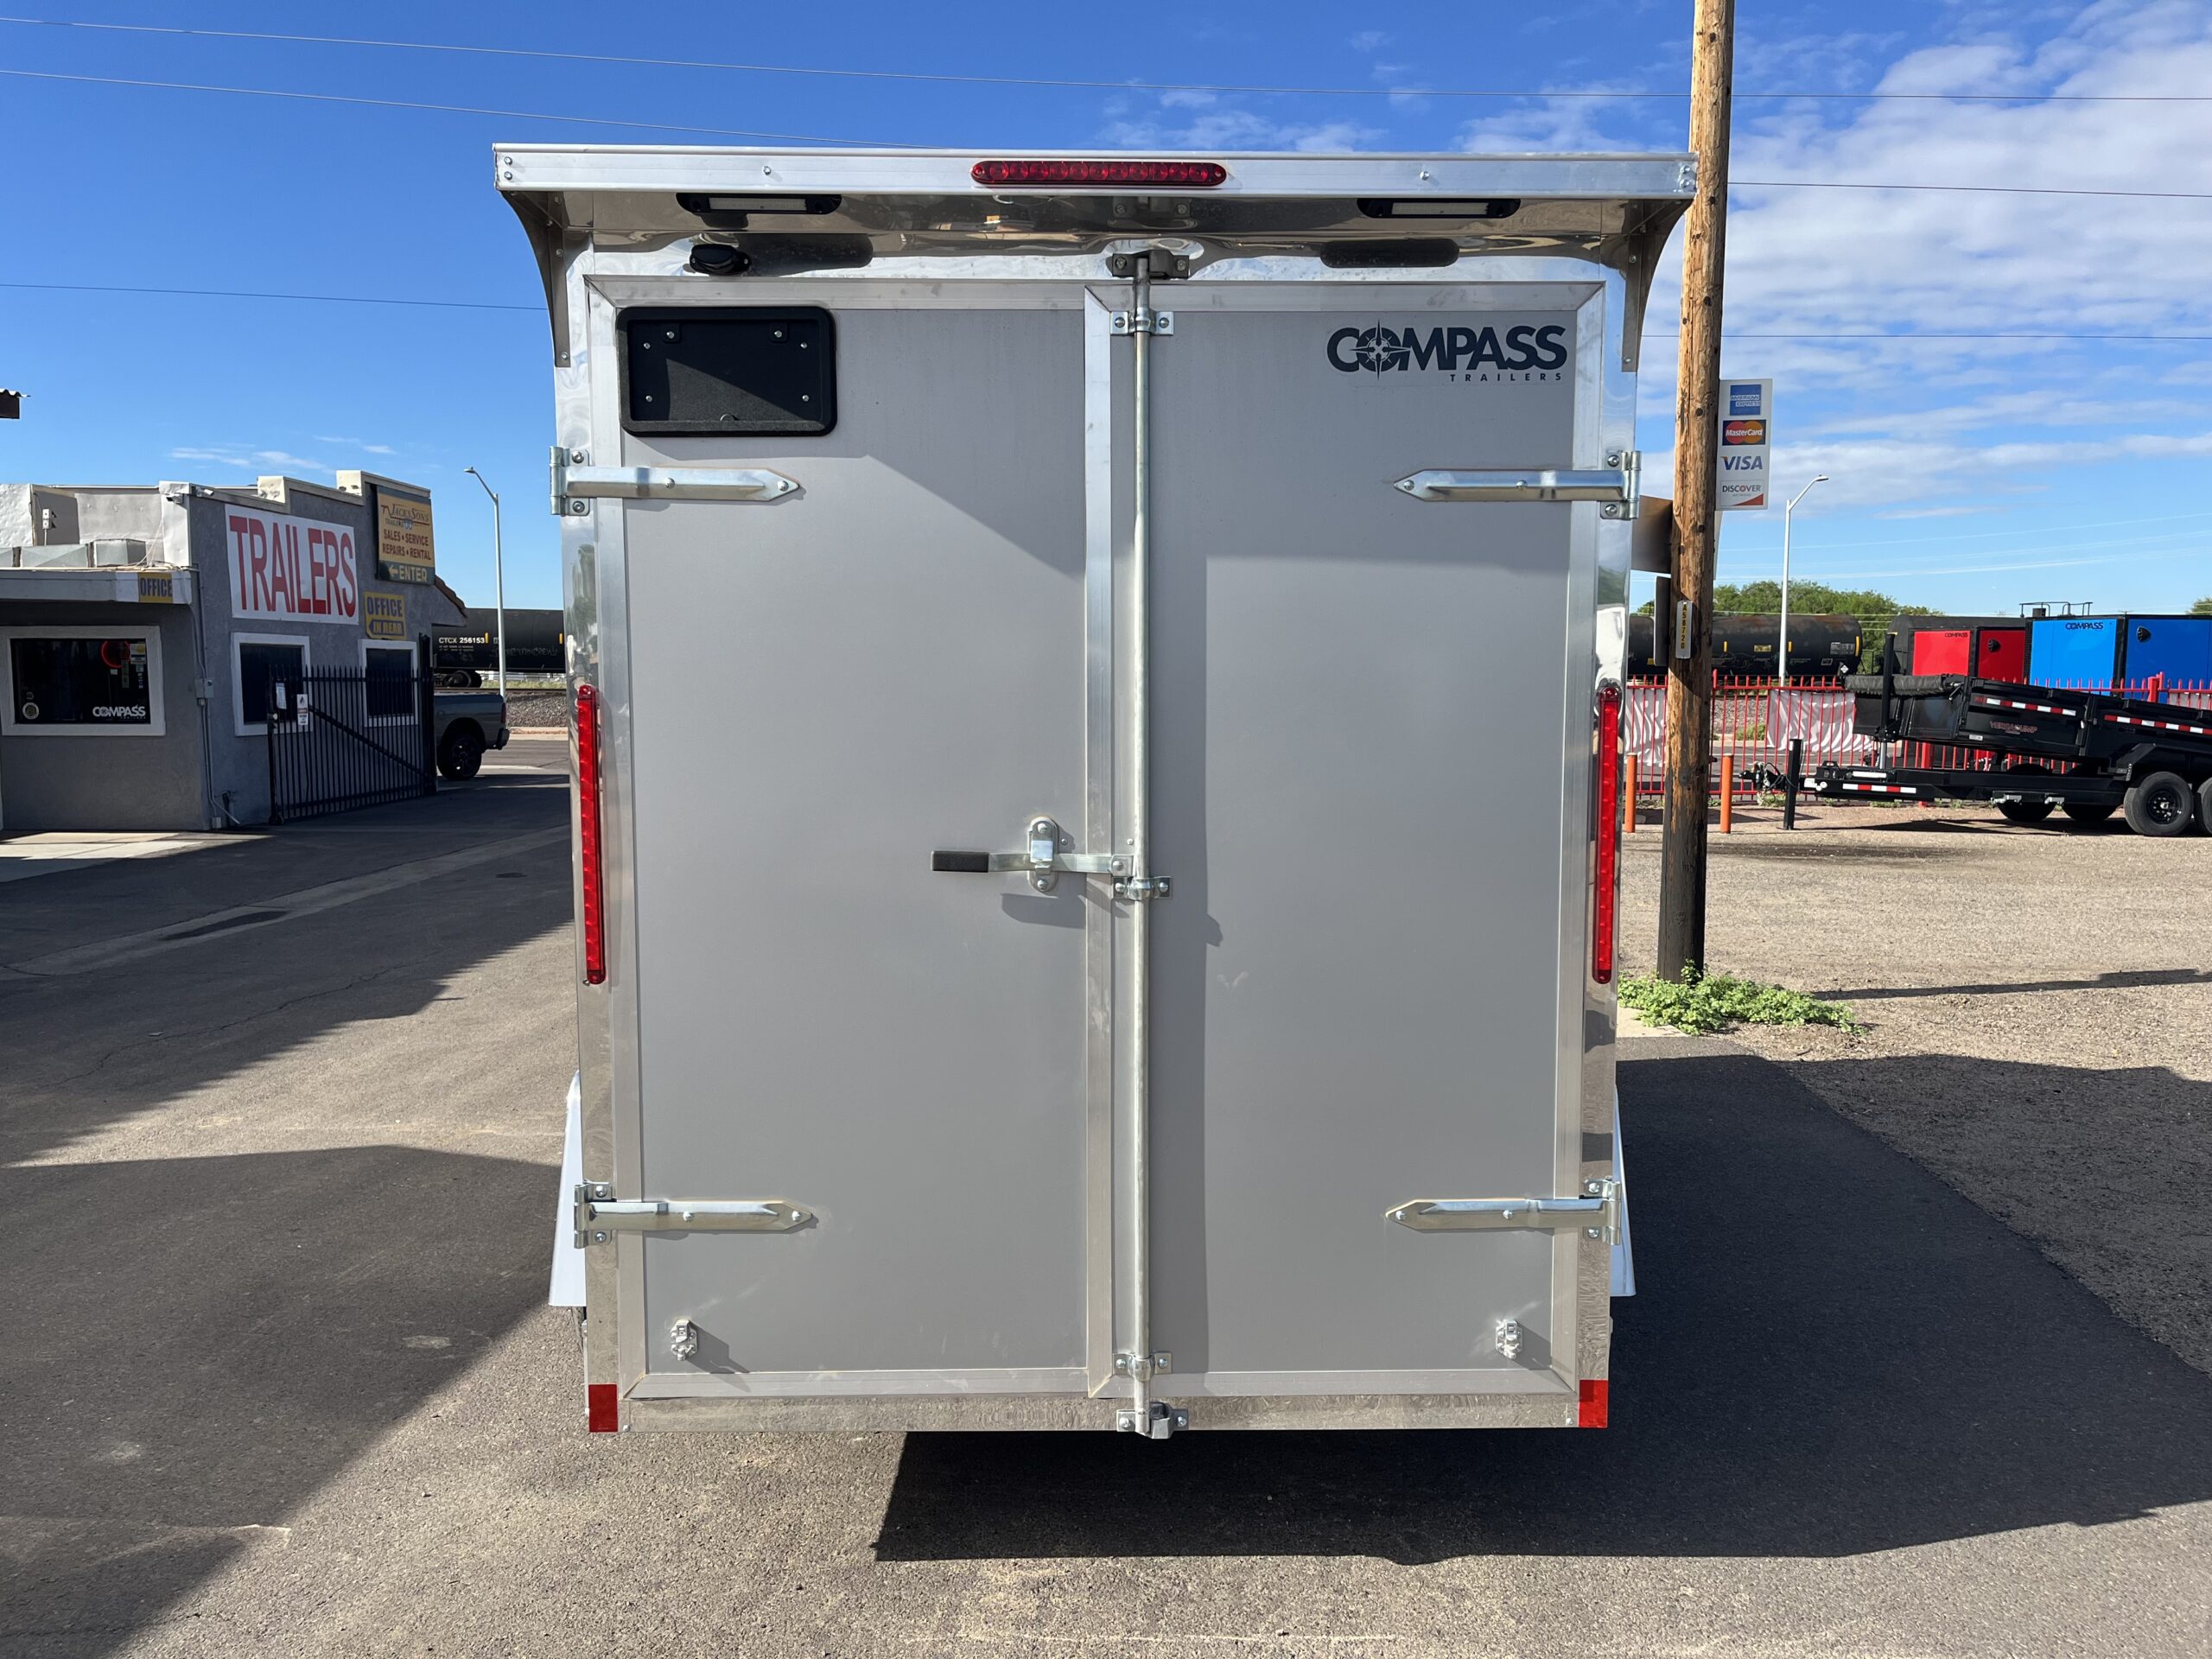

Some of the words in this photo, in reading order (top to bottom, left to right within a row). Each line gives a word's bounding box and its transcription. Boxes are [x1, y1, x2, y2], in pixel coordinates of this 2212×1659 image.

[1326, 324, 1567, 372] COMPASS
[1450, 372, 1561, 382] TRAILERS
[1721, 456, 1764, 470] VISA
[384, 529, 401, 542] SALES
[405, 532, 429, 546] SERVICE
[382, 543, 405, 556] REPAIRS
[410, 548, 431, 560] RENTAL
[229, 515, 356, 618] TRAILERS
[399, 565, 428, 582] ENTER
[140, 577, 173, 597] OFFICE
[367, 596, 403, 617] OFFICE
[372, 620, 382, 633] IN
[383, 622, 402, 635] REAR
[2065, 621, 2104, 630] COMPASS
[92, 705, 146, 717] COMPASS
